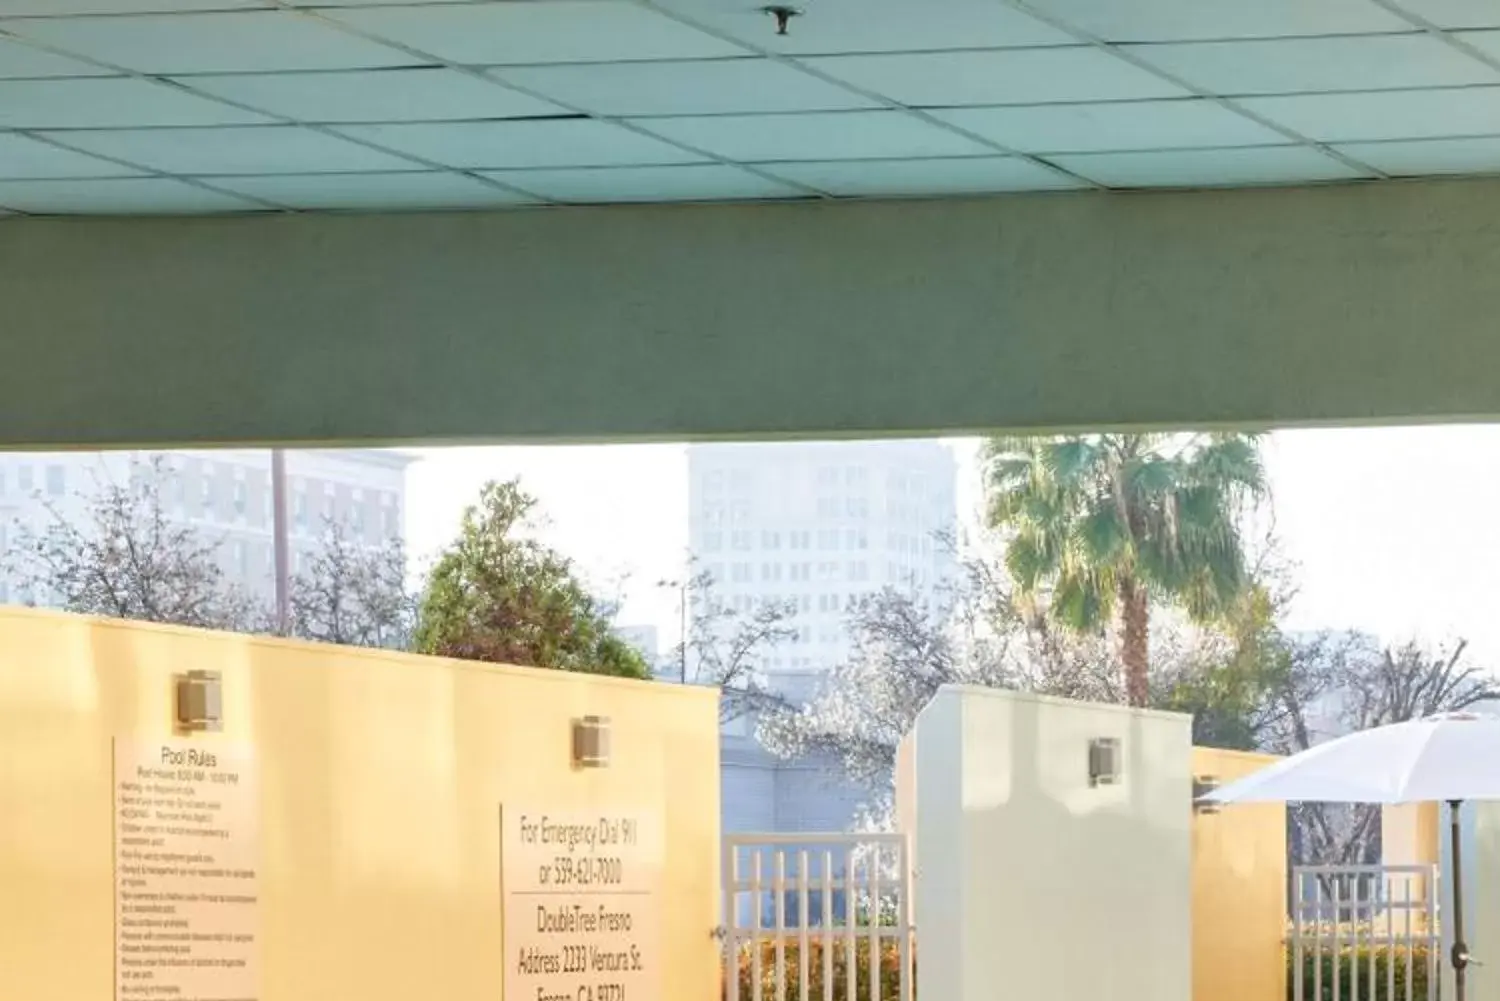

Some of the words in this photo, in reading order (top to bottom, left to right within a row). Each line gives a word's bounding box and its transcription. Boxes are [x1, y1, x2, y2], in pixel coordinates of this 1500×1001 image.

[161, 746, 185, 765] Pool
[187, 748, 217, 767] Rules
[521, 815, 539, 845] For
[541, 815, 597, 852] Emergency
[600, 817, 619, 844] Dial
[621, 818, 638, 845] 911
[539, 865, 551, 884] or
[537, 904, 597, 933] DoubleTree
[599, 904, 632, 932] Fresno
[517, 946, 560, 975] Address
[563, 945, 587, 973] 2233
[590, 945, 629, 972] Ventura
